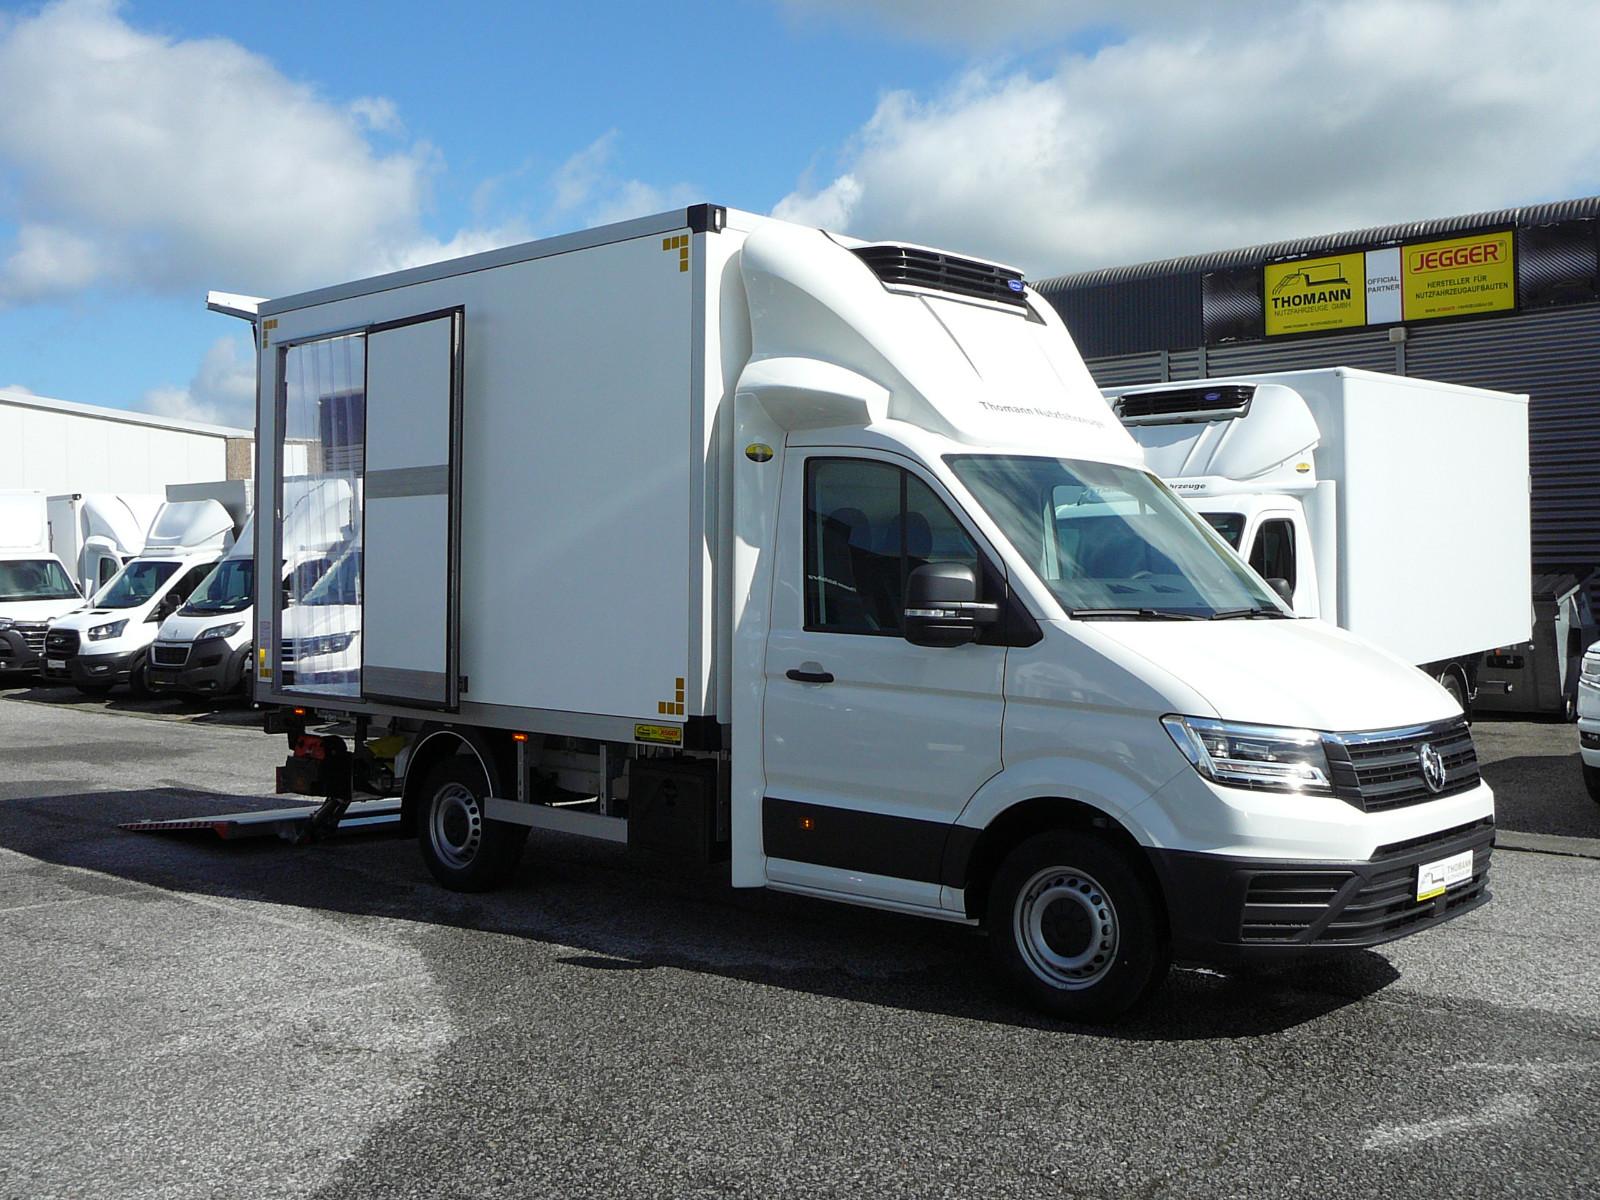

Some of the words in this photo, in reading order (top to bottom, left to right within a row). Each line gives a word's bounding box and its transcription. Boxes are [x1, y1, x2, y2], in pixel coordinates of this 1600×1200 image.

[1413, 244, 1498, 272] JEGGER
[1367, 275, 1399, 285] OFFICIAL
[1427, 277, 1470, 289] HERSTELLER
[1473, 274, 1488, 283] FÜR
[1367, 284, 1400, 293] PARTNER
[1415, 282, 1509, 299] NUTZFAHRZEUGAUFBAUTEN
[1272, 288, 1351, 309] THOMANN
[1274, 304, 1329, 317] NUTZFAHRZEUGE
[978, 400, 1034, 415] Thomann
